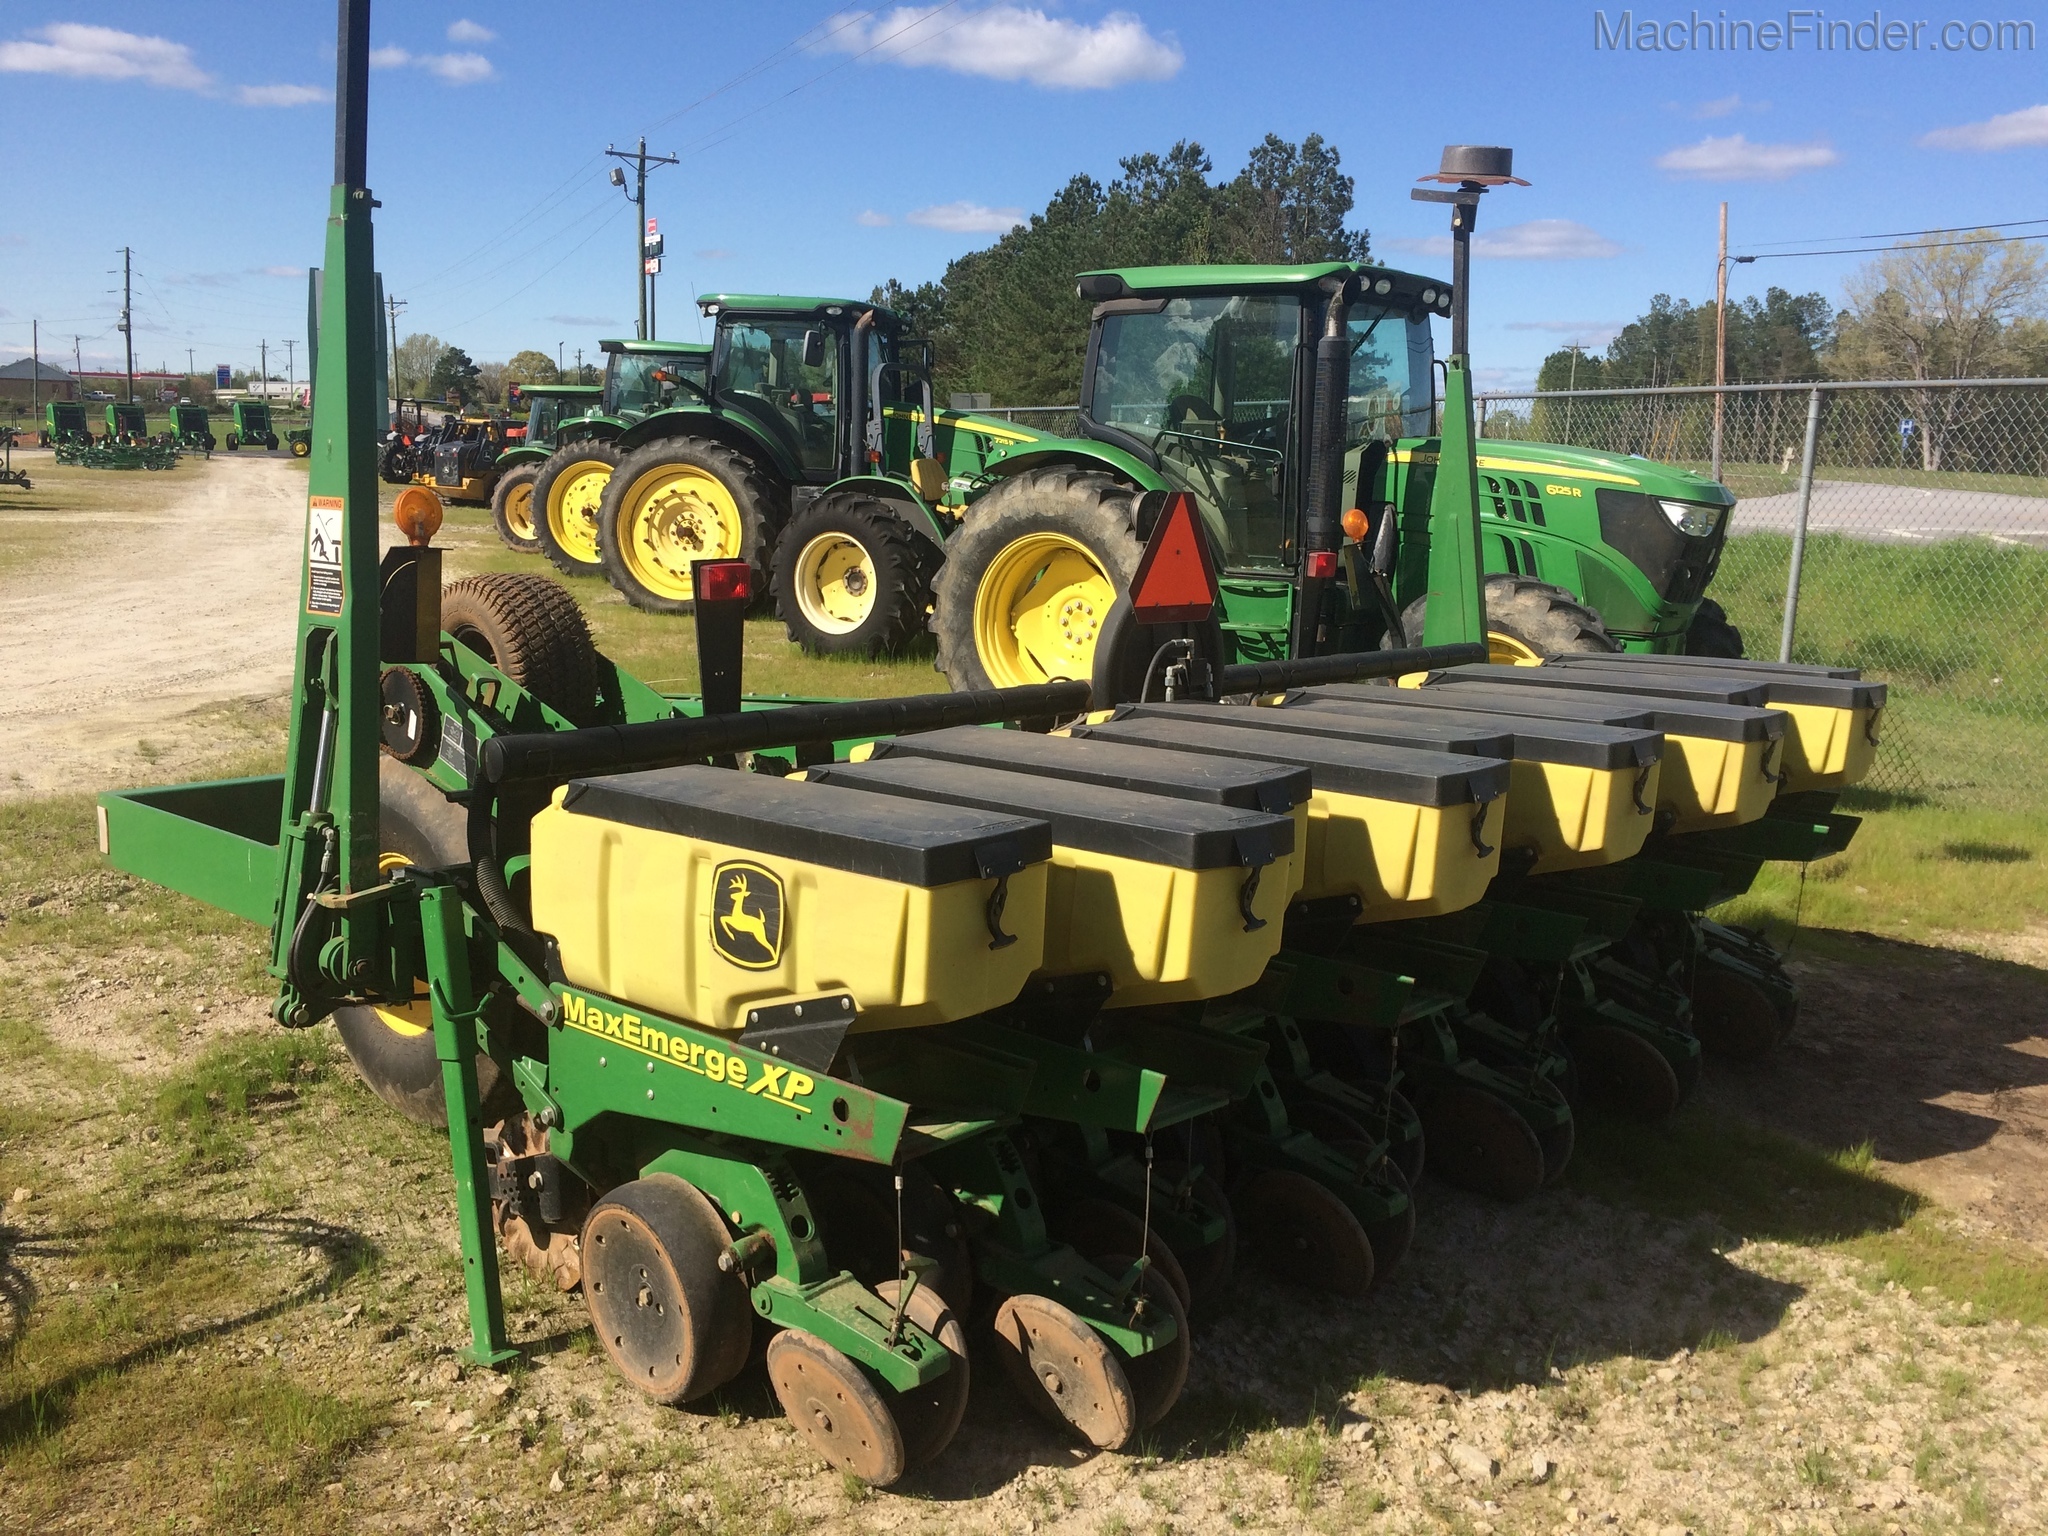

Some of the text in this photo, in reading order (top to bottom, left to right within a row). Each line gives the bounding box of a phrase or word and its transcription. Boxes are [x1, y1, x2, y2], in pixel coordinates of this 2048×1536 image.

[1420, 454, 1440, 463] JOH
[1546, 485, 1582, 497] 6125 R
[318, 499, 342, 508] WARNING
[562, 991, 815, 1101] MaxEmerge XP
